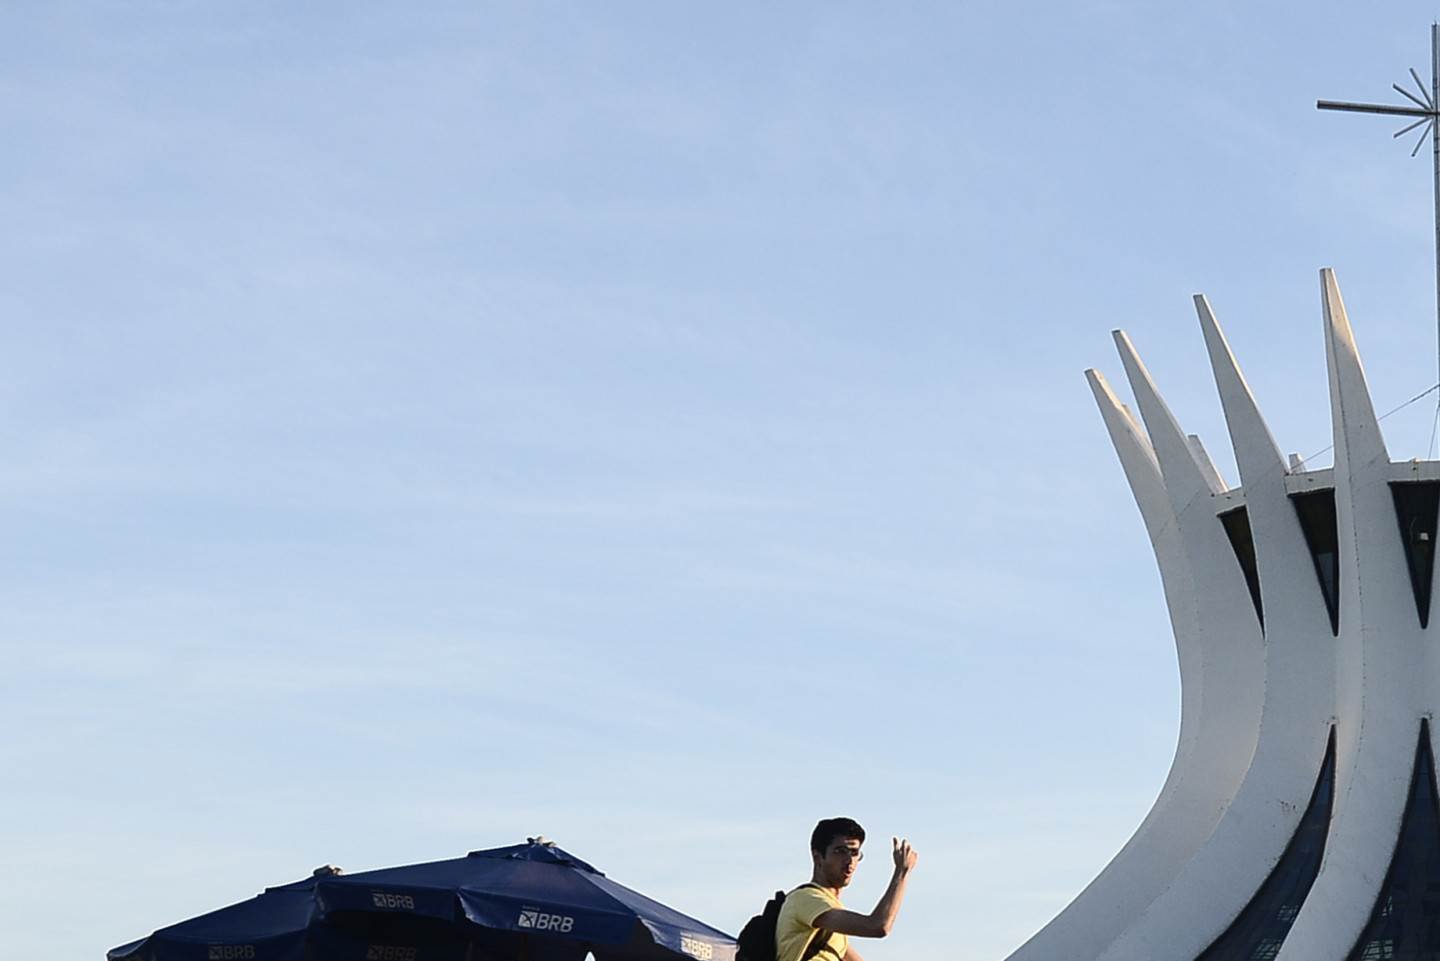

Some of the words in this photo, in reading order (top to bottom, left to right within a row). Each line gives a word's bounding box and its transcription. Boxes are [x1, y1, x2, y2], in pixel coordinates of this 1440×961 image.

[385, 894, 415, 909] BRB
[536, 913, 574, 933] BRB
[223, 944, 256, 960] BRB
[384, 946, 416, 961] BRB
[691, 939, 713, 959] BRB
